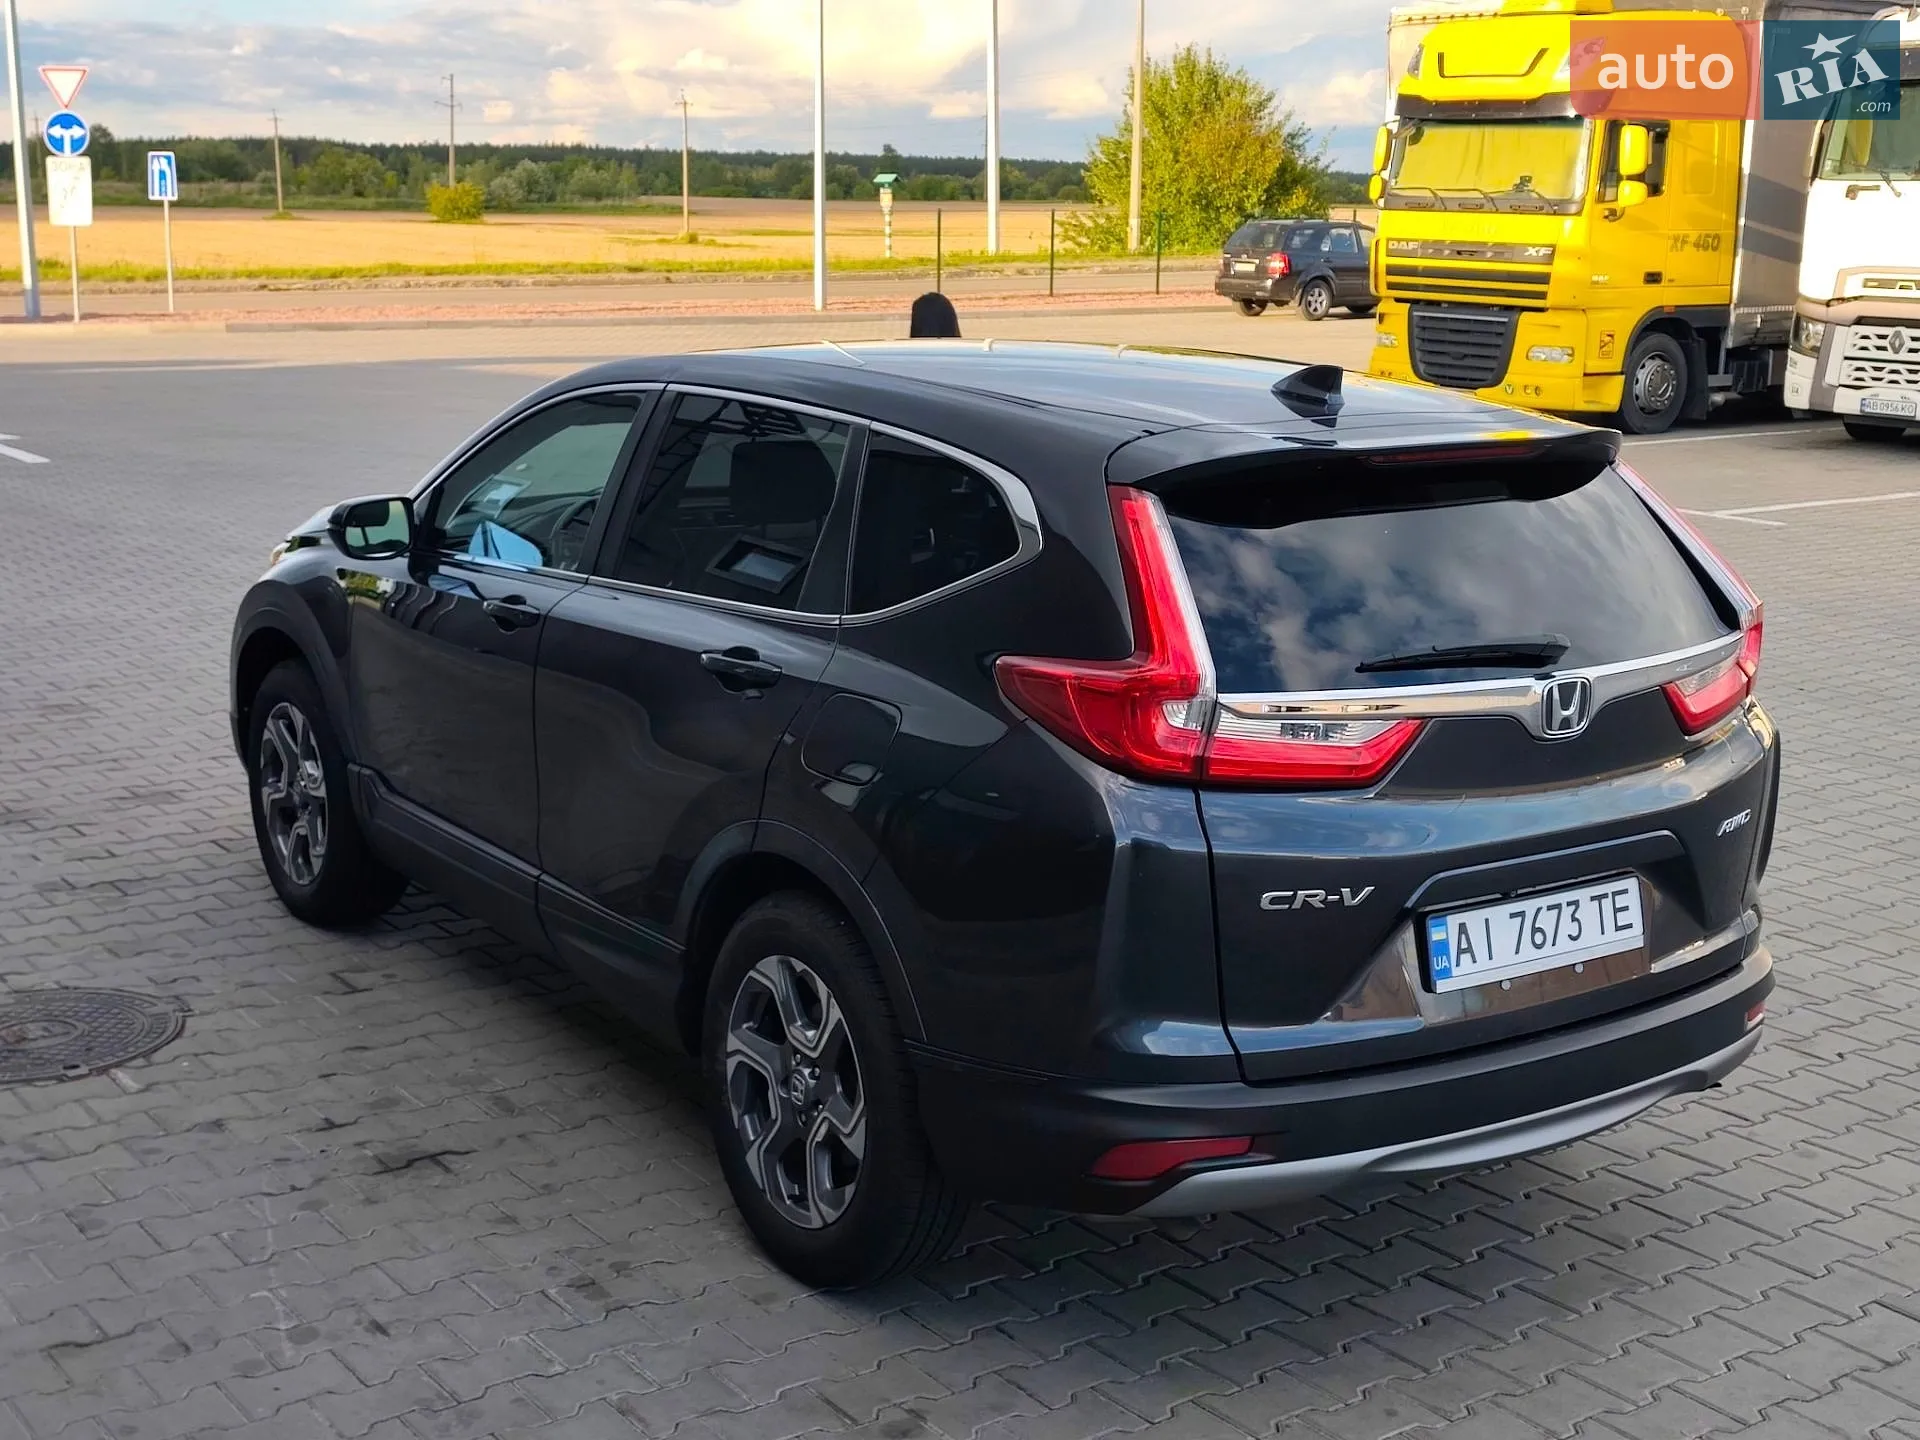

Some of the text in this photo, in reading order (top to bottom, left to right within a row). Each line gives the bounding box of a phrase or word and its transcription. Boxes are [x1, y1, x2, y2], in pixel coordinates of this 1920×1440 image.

[1388, 240, 1419, 250] DAF
[1523, 246, 1554, 257] XF
[1260, 885, 1375, 910] CR-V
[1455, 888, 1633, 967] AI 7673 TE
[1433, 956, 1450, 970] UA
